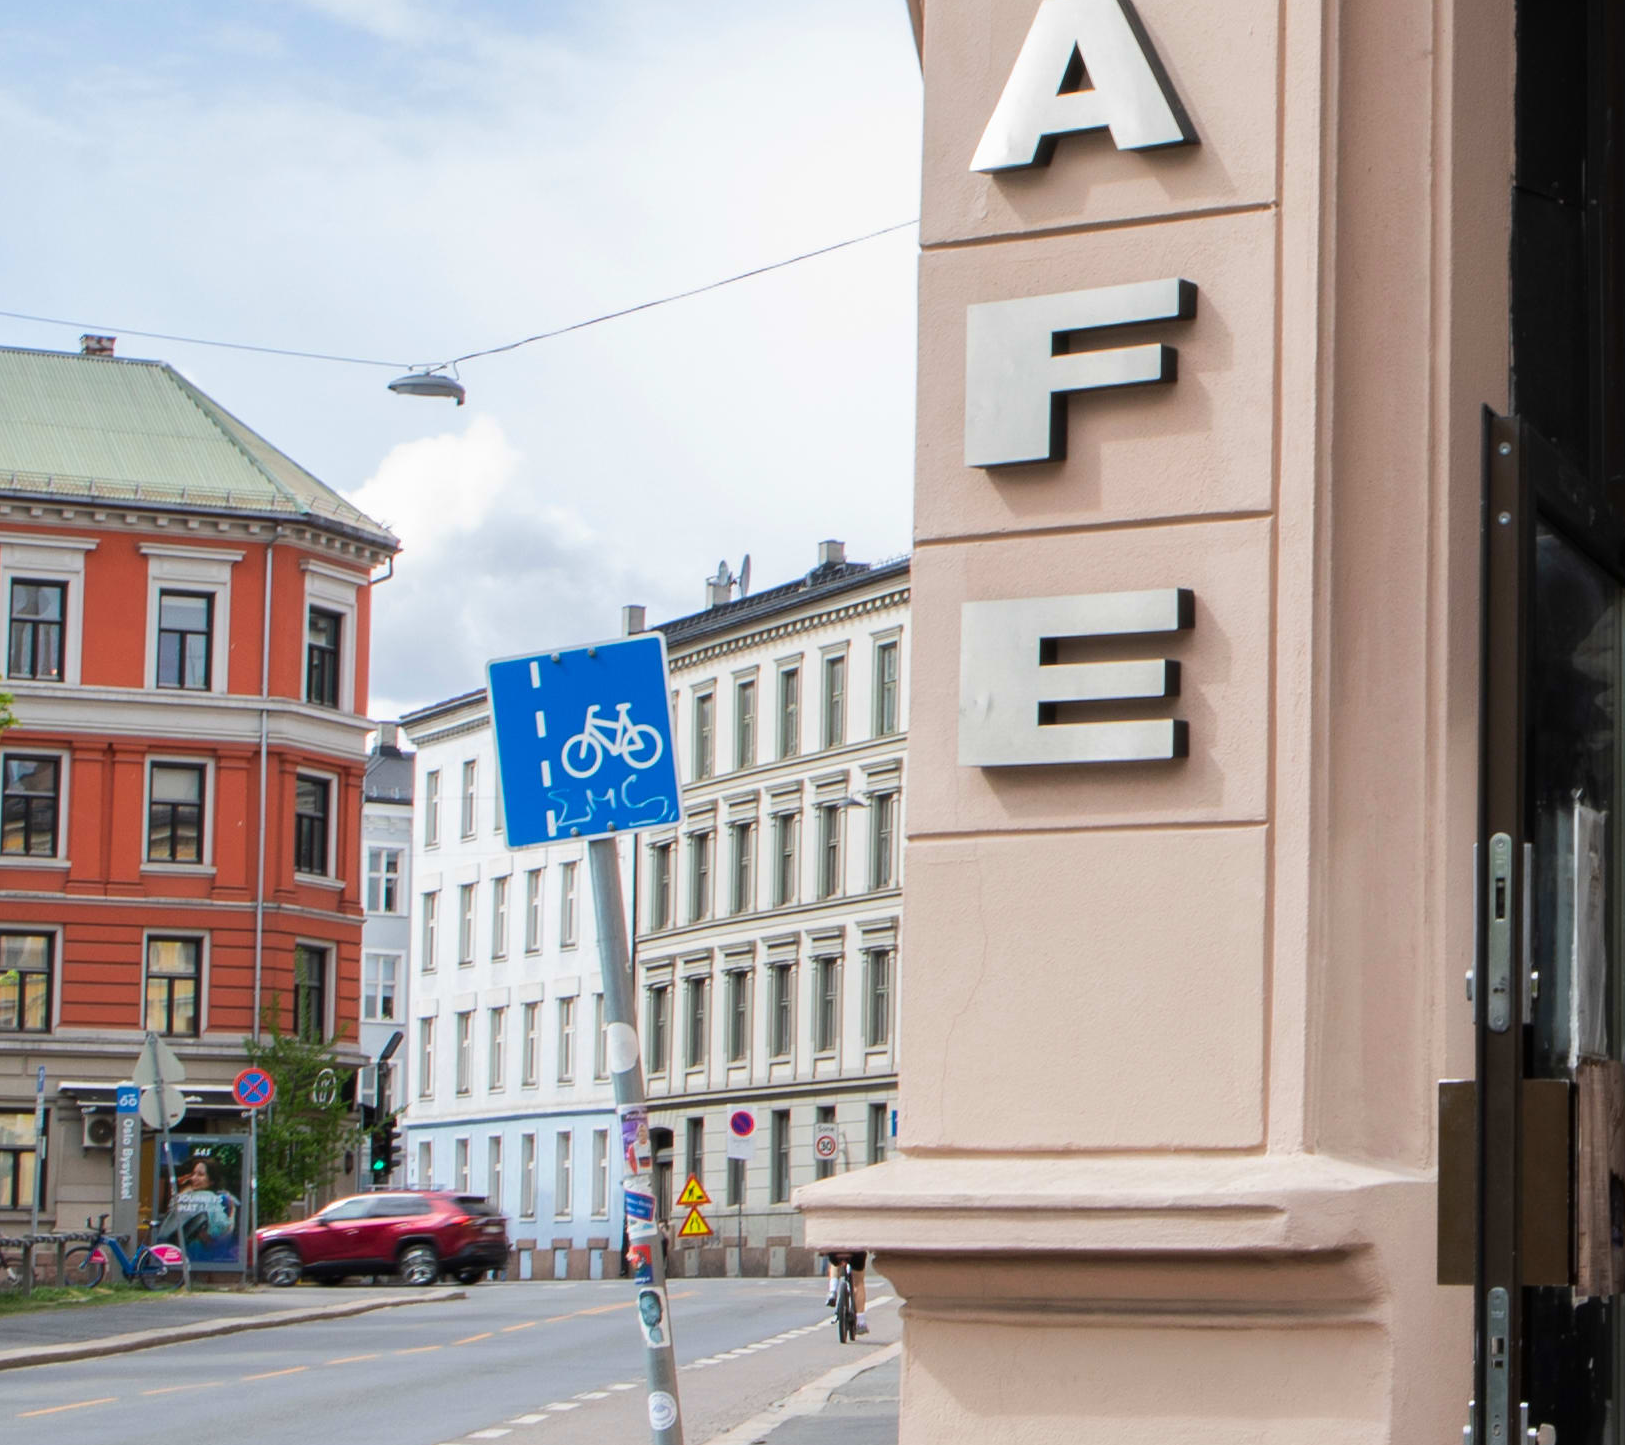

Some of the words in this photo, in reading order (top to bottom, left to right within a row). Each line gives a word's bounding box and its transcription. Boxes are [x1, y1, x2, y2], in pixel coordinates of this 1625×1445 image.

[122, 1118, 135, 1146] Oslo
[817, 1124, 836, 1134] Sone
[820, 1140, 833, 1153] 30
[119, 1148, 135, 1200] Bysykkel
